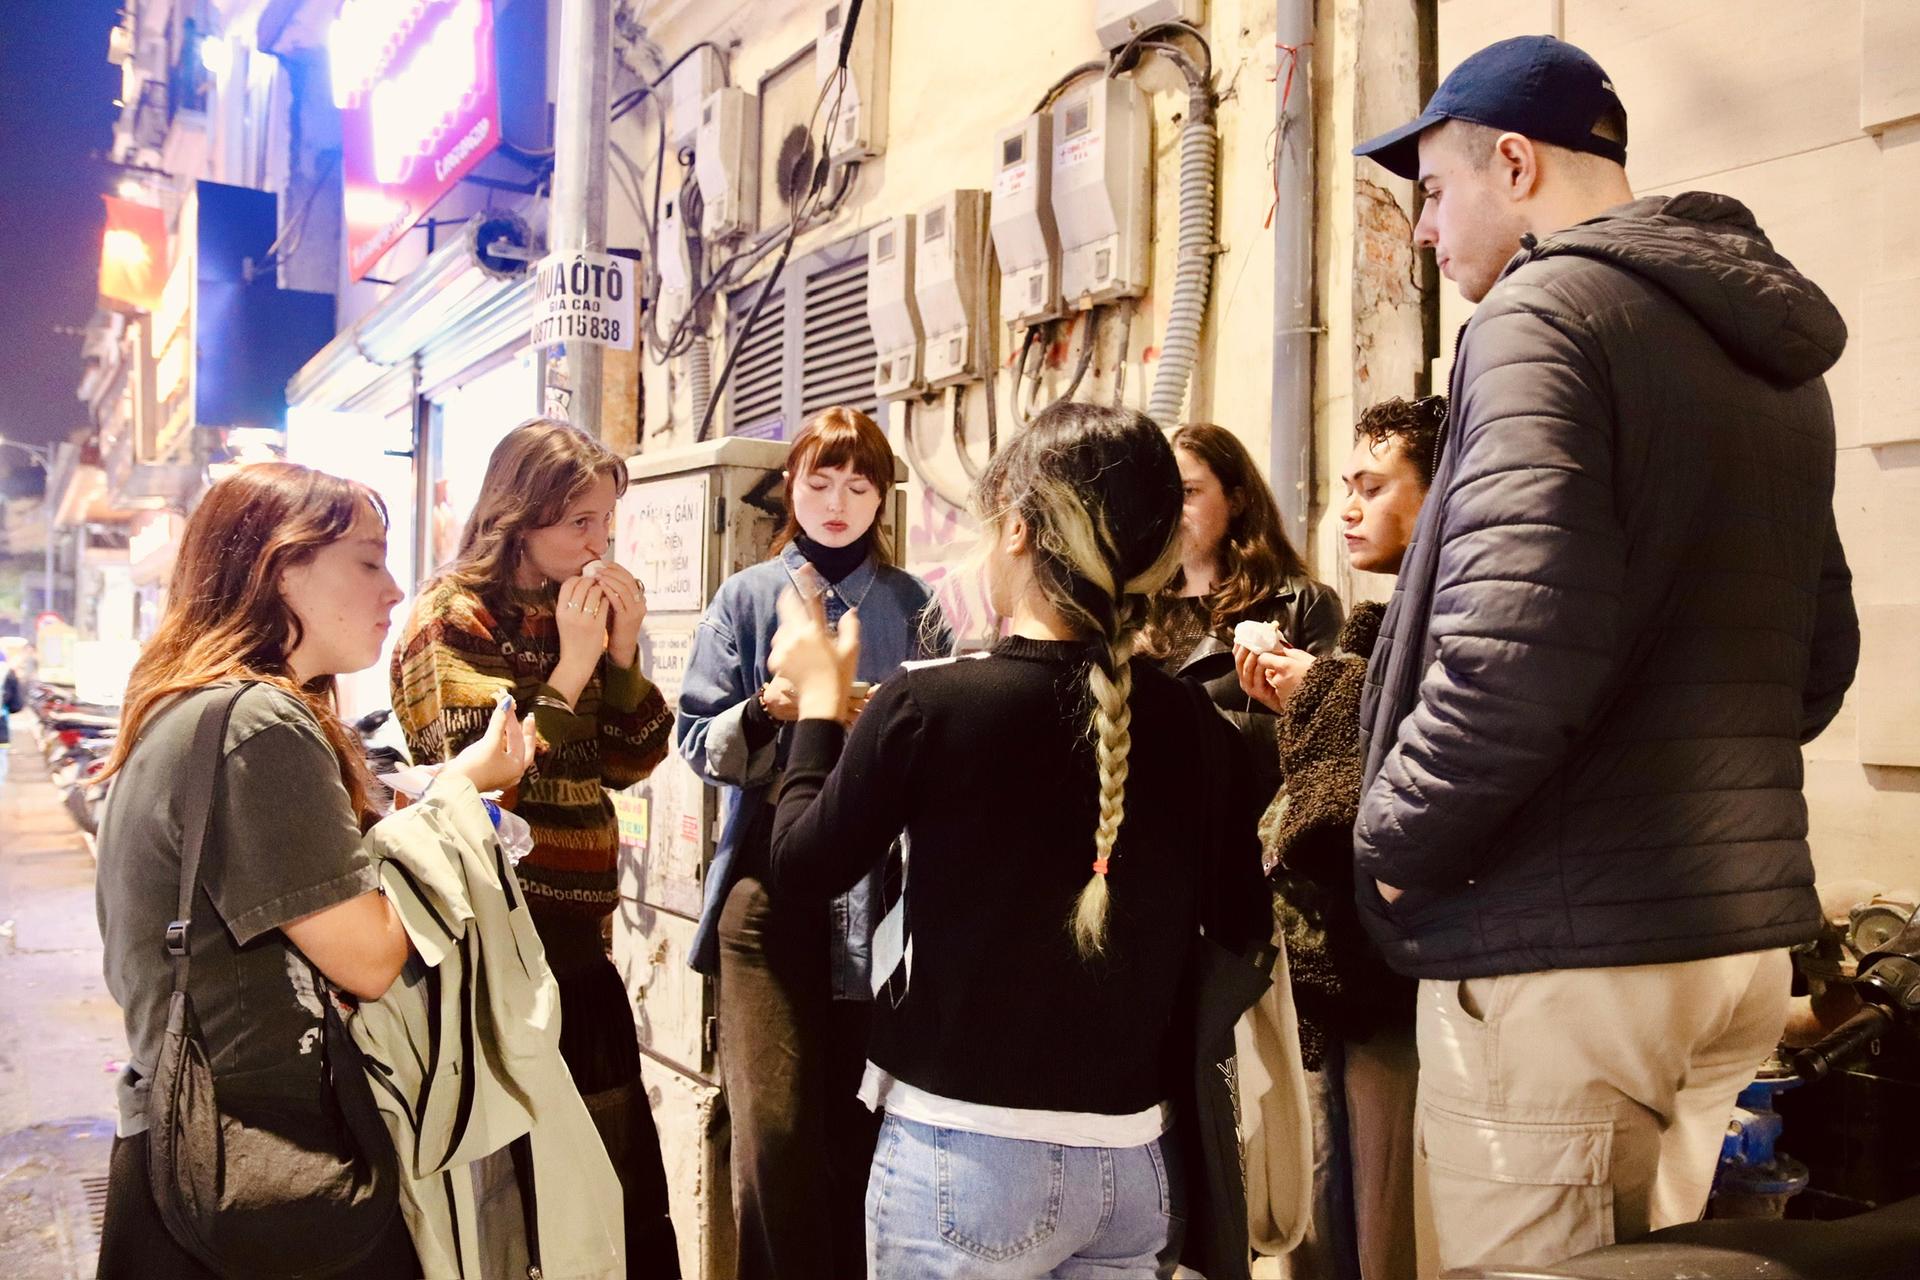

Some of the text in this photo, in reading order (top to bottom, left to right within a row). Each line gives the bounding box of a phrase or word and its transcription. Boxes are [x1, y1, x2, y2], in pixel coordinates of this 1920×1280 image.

[536, 262, 566, 303] MUA
[572, 299, 600, 312] CAO
[652, 655, 678, 670] PILLAR
